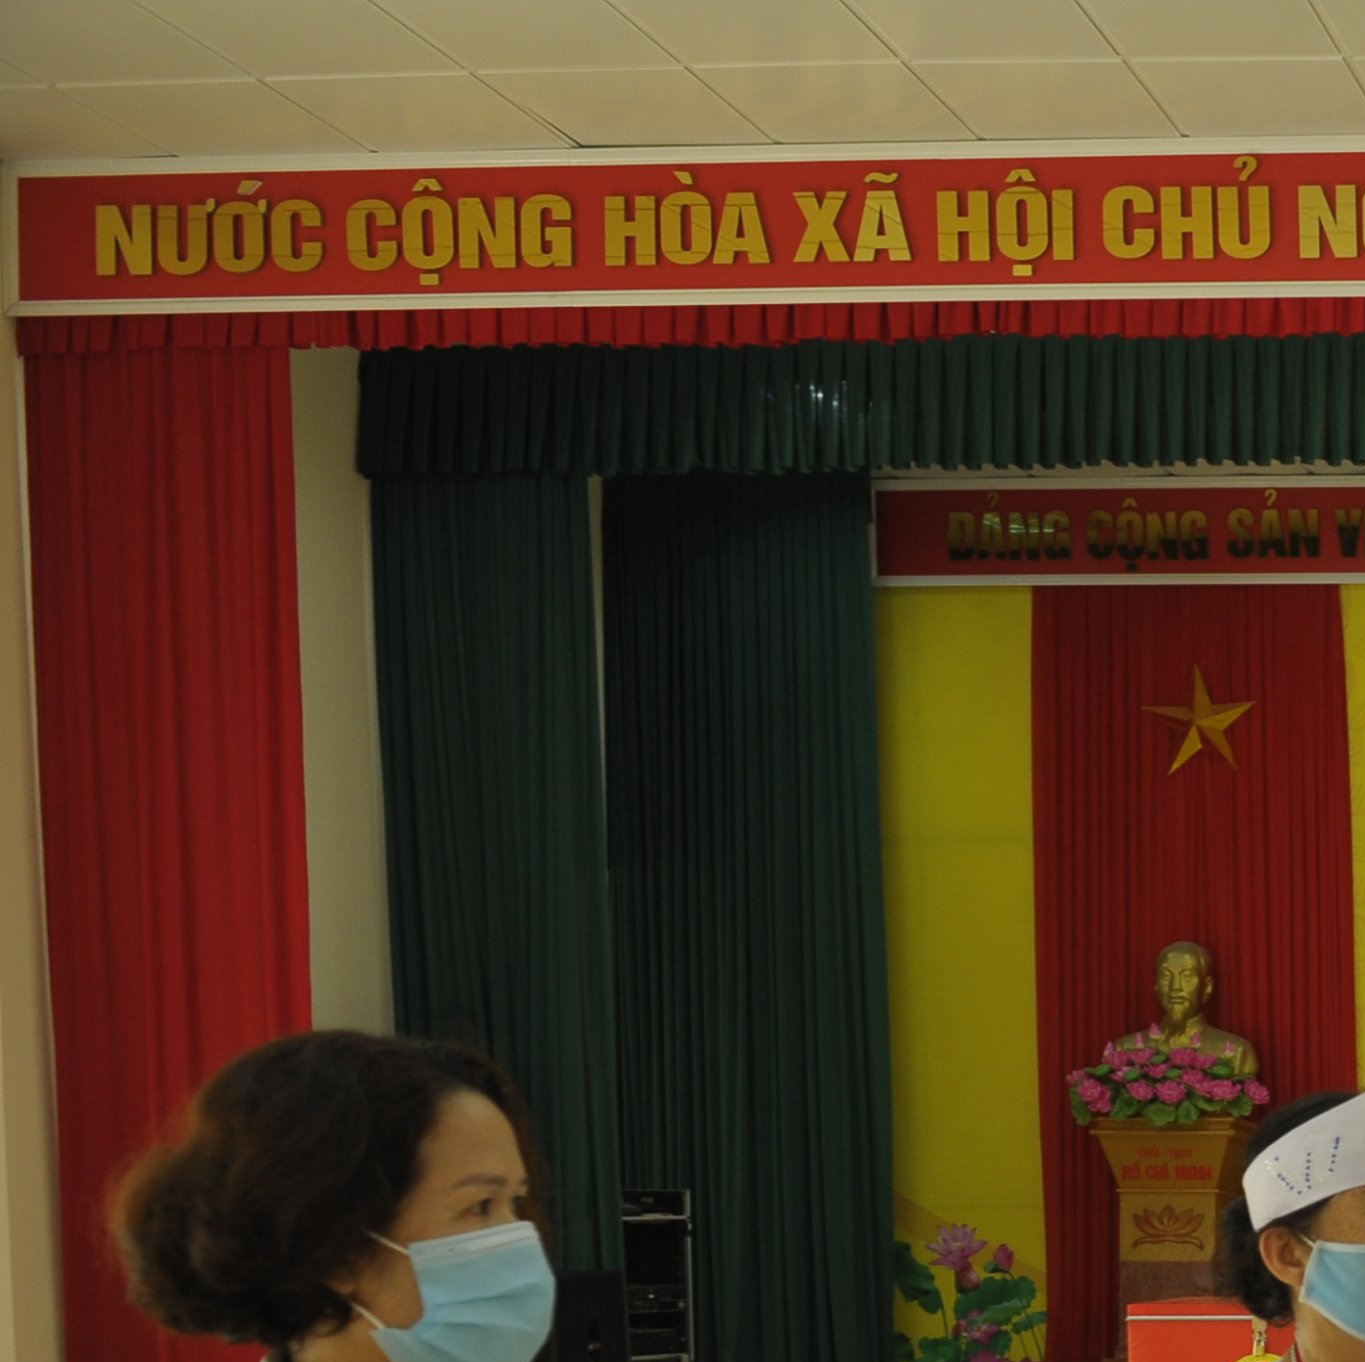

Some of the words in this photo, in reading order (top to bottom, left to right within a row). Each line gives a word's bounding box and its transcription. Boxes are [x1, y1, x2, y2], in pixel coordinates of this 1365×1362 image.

[96, 180, 322, 275] NƯỚC
[347, 178, 573, 286] CỘNG
[605, 170, 768, 268] HÒA
[797, 172, 910, 264] XÃ
[938, 169, 1075, 277] HỘI
[1103, 156, 1272, 261] CHỦ
[947, 491, 1071, 560] ĐẢNG
[1086, 498, 1210, 571] CỘNG
[1226, 489, 1321, 559] SẢN
